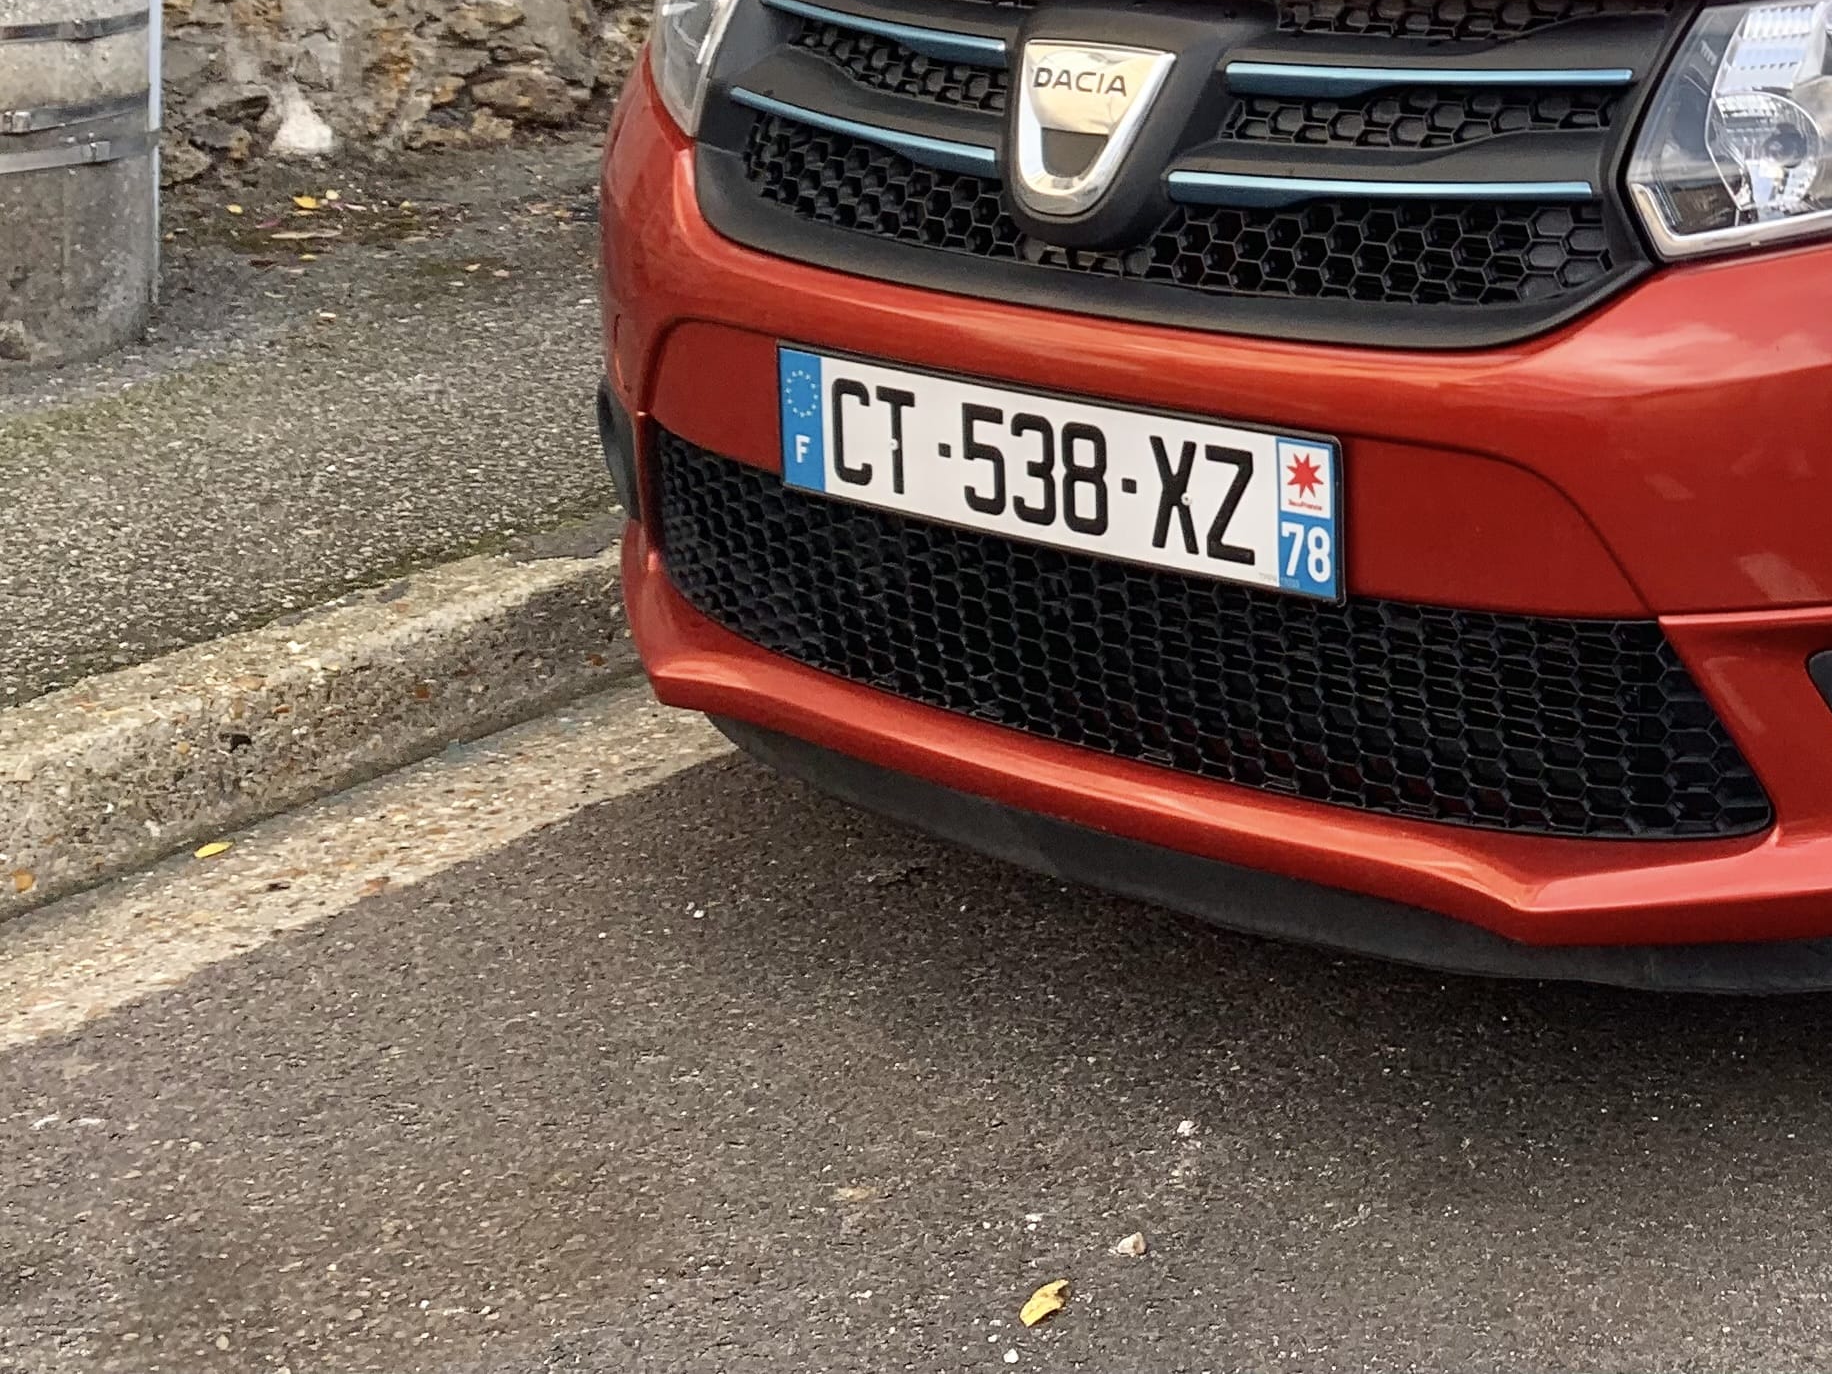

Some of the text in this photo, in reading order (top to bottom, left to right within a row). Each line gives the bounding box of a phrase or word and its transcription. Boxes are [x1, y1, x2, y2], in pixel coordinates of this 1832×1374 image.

[1033, 67, 1127, 97] DACIA
[795, 437, 811, 464] F
[1281, 521, 1331, 583] 78
